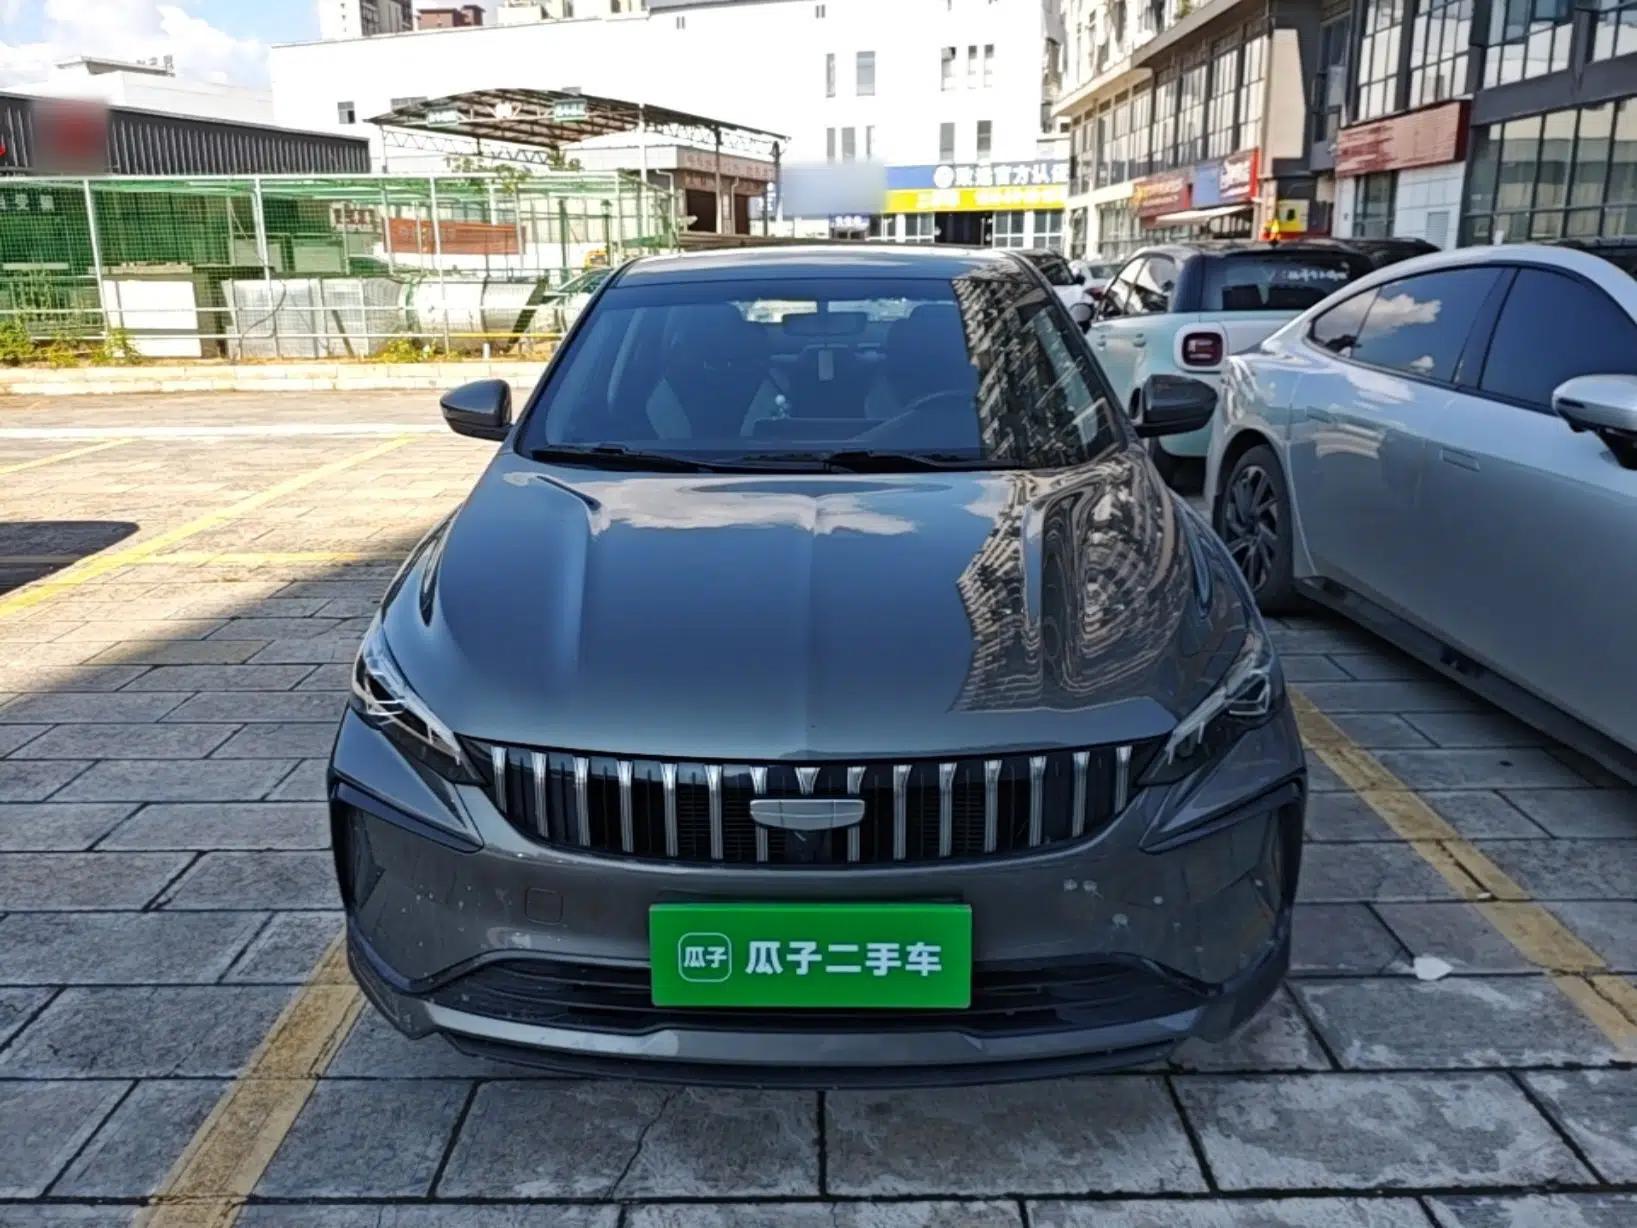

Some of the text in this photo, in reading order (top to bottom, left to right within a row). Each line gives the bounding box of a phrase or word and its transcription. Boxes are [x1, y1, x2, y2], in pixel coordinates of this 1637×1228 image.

[683, 946, 727, 968] 瓜子
[745, 941, 942, 976] 瓜子二手车
